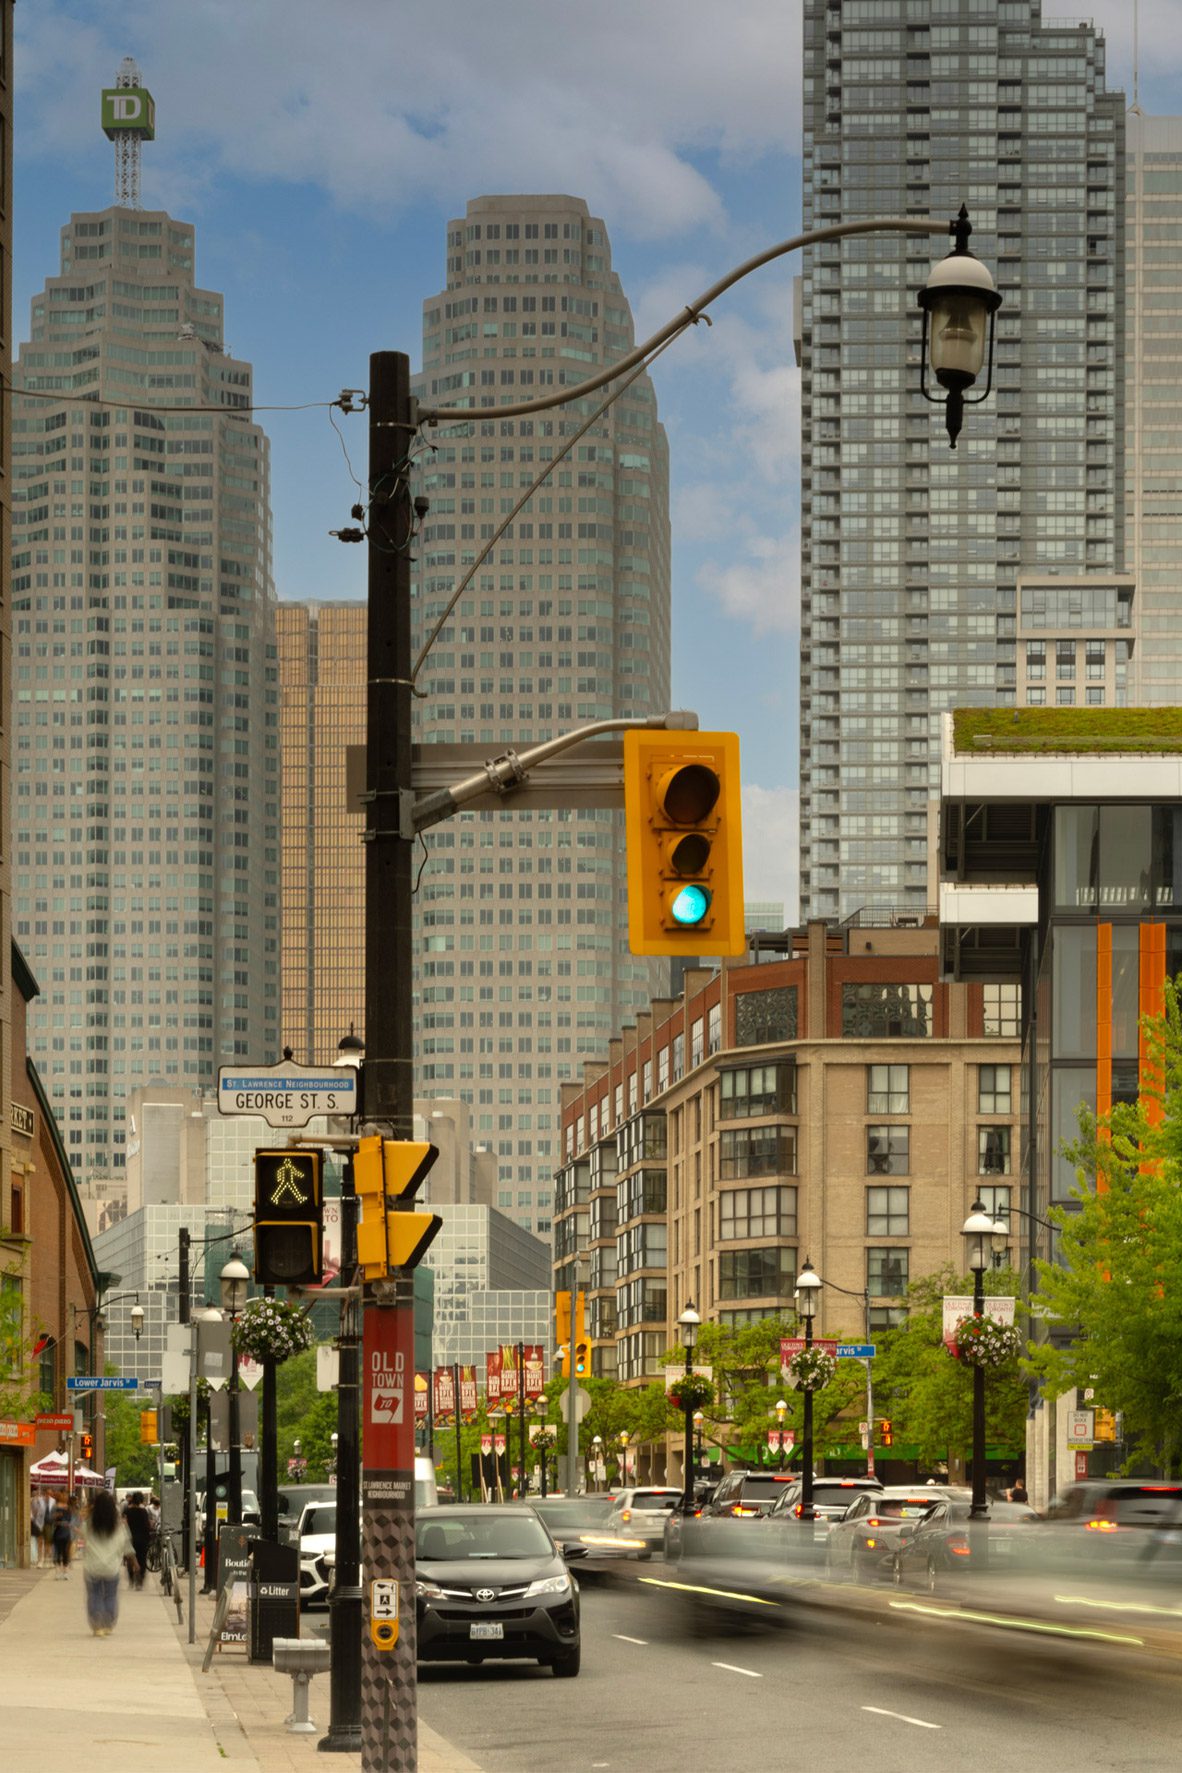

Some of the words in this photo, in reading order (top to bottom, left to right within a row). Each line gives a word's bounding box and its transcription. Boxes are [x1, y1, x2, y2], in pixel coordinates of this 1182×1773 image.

[106, 95, 142, 120] TD
[236, 1092, 294, 1110] GEORGE
[300, 1093, 321, 1110] ST.
[327, 1093, 339, 1110] S.
[281, 1115, 294, 1123] 112
[836, 1347, 856, 1355] arvis
[371, 1351, 405, 1372] OLD
[75, 1378, 98, 1387] Lower
[100, 1378, 124, 1387] Jarvis
[371, 1373, 404, 1389] TOWN
[380, 1399, 393, 1409] TO
[393, 1481, 411, 1490] MARKET
[268, 1585, 290, 1597] Litter
